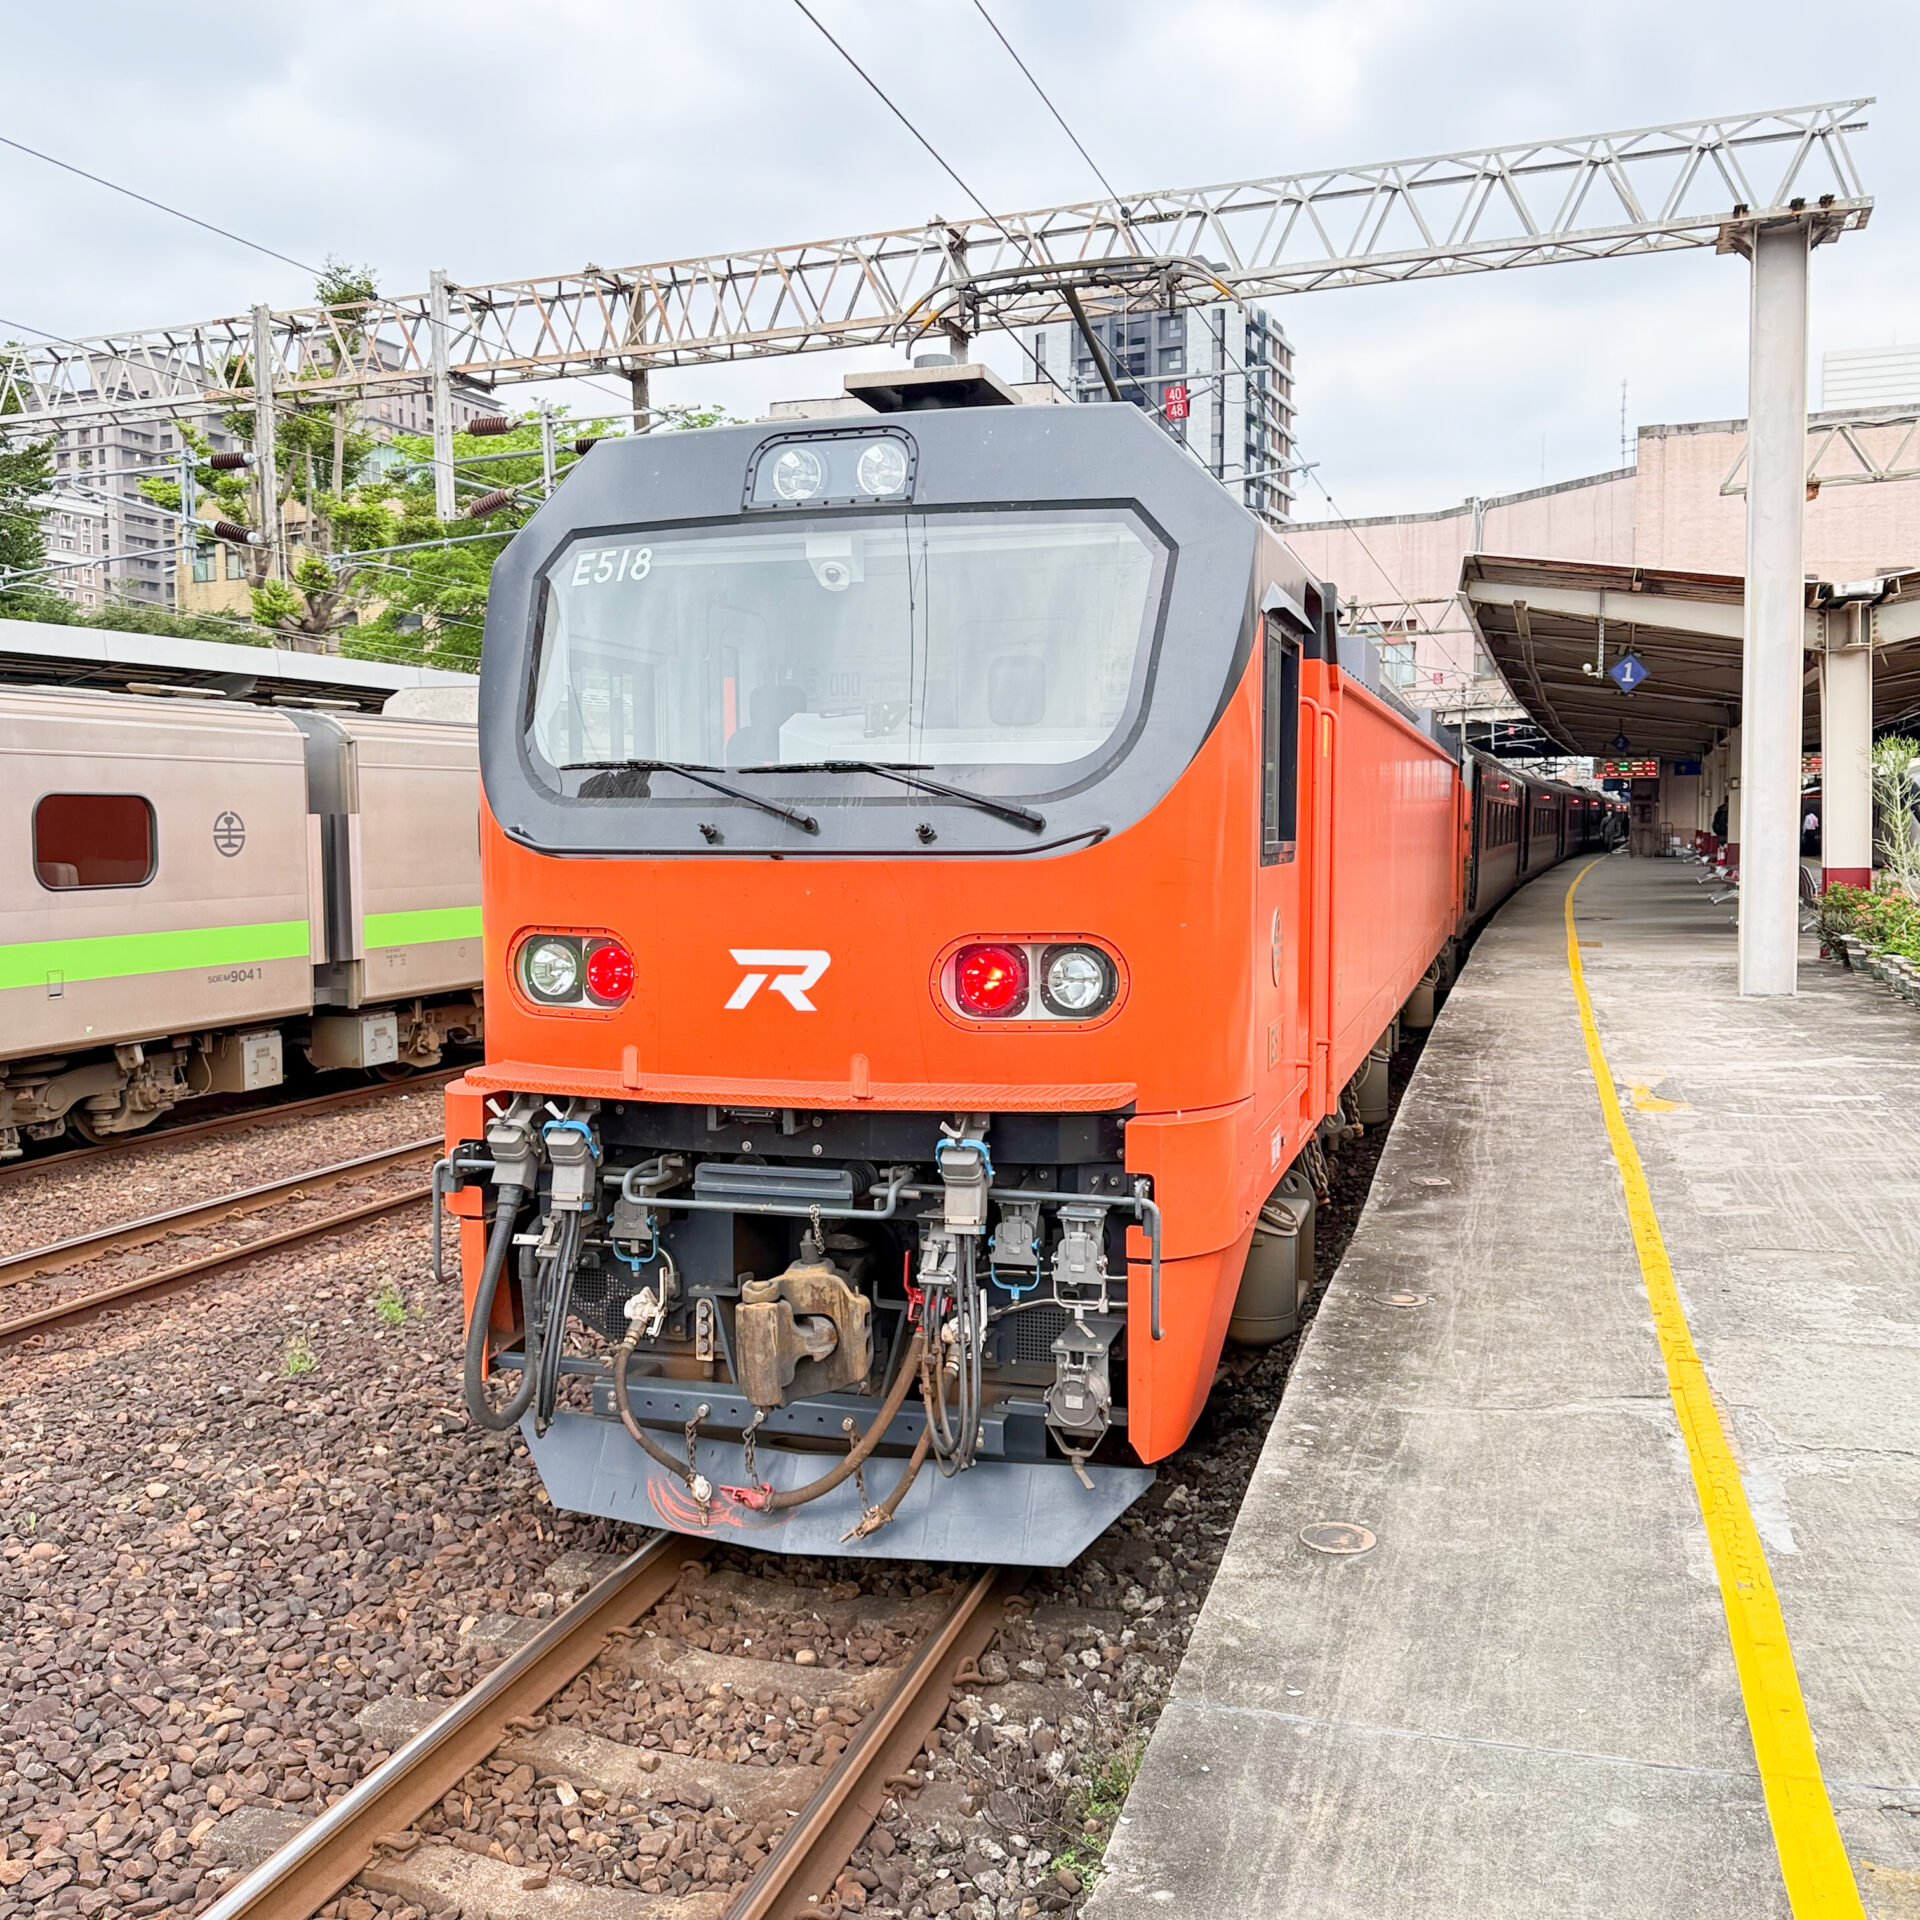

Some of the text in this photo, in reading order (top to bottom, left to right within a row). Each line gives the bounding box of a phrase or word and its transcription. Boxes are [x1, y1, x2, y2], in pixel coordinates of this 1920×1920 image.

[1168, 387, 1182, 400] 40
[1171, 403, 1184, 416] 48
[571, 547, 653, 587] E518
[1622, 662, 1634, 682] 1
